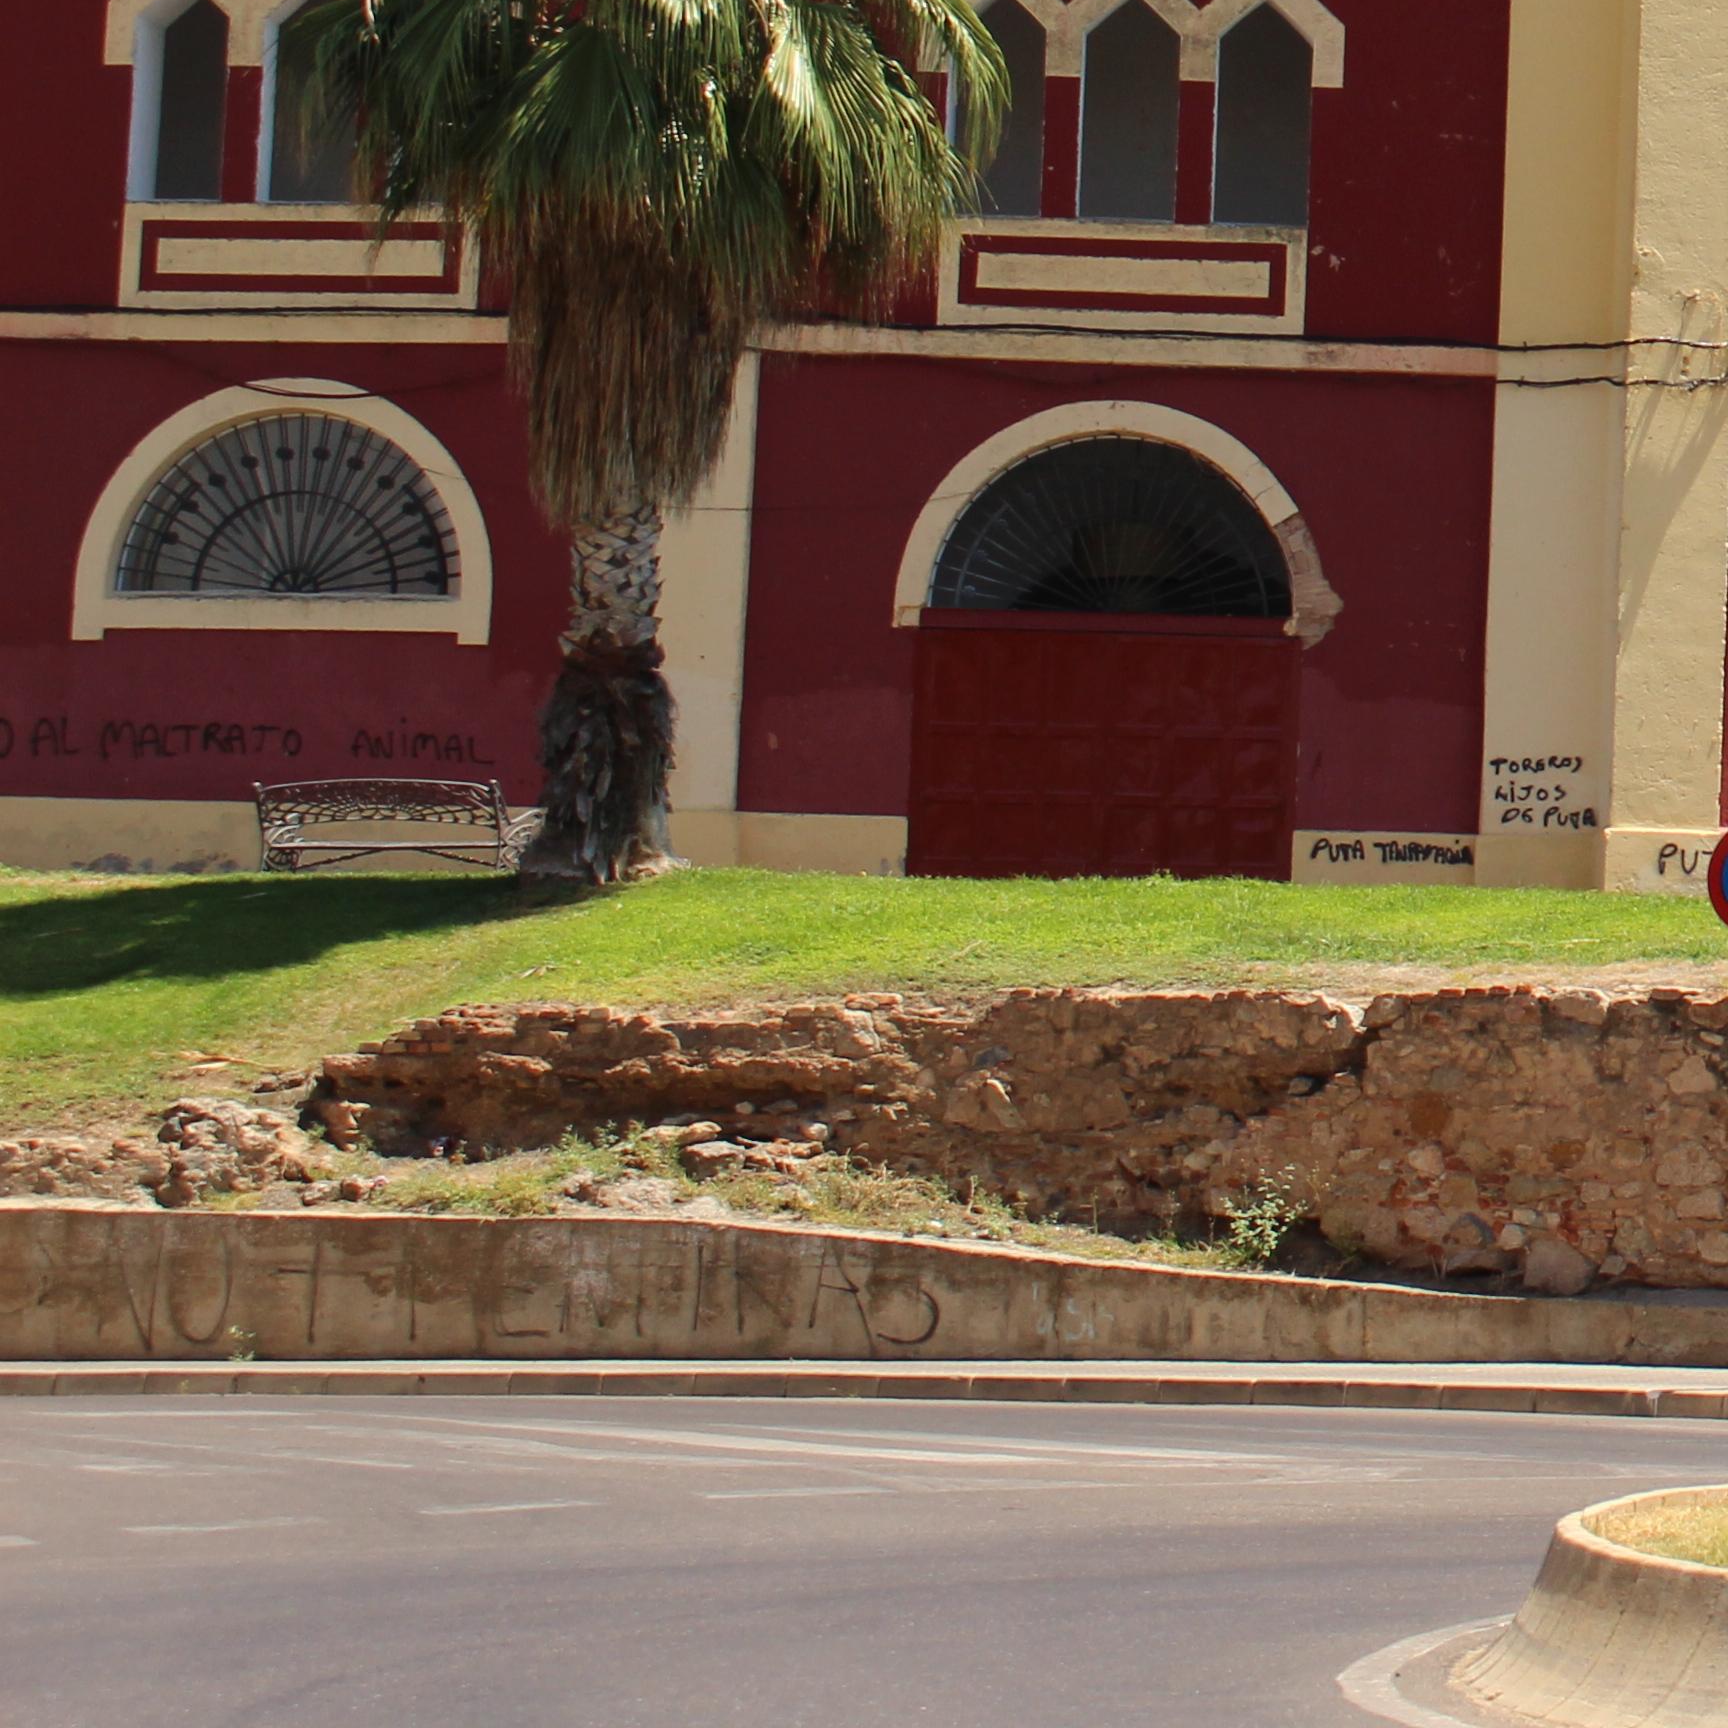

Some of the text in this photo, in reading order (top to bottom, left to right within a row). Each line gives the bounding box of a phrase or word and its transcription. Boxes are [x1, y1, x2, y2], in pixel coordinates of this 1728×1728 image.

[31, 716, 79, 757] AL
[98, 721, 303, 760] MALTRATO
[1543, 806, 1597, 829] PUTA
[1310, 838, 1365, 863] PUTA
